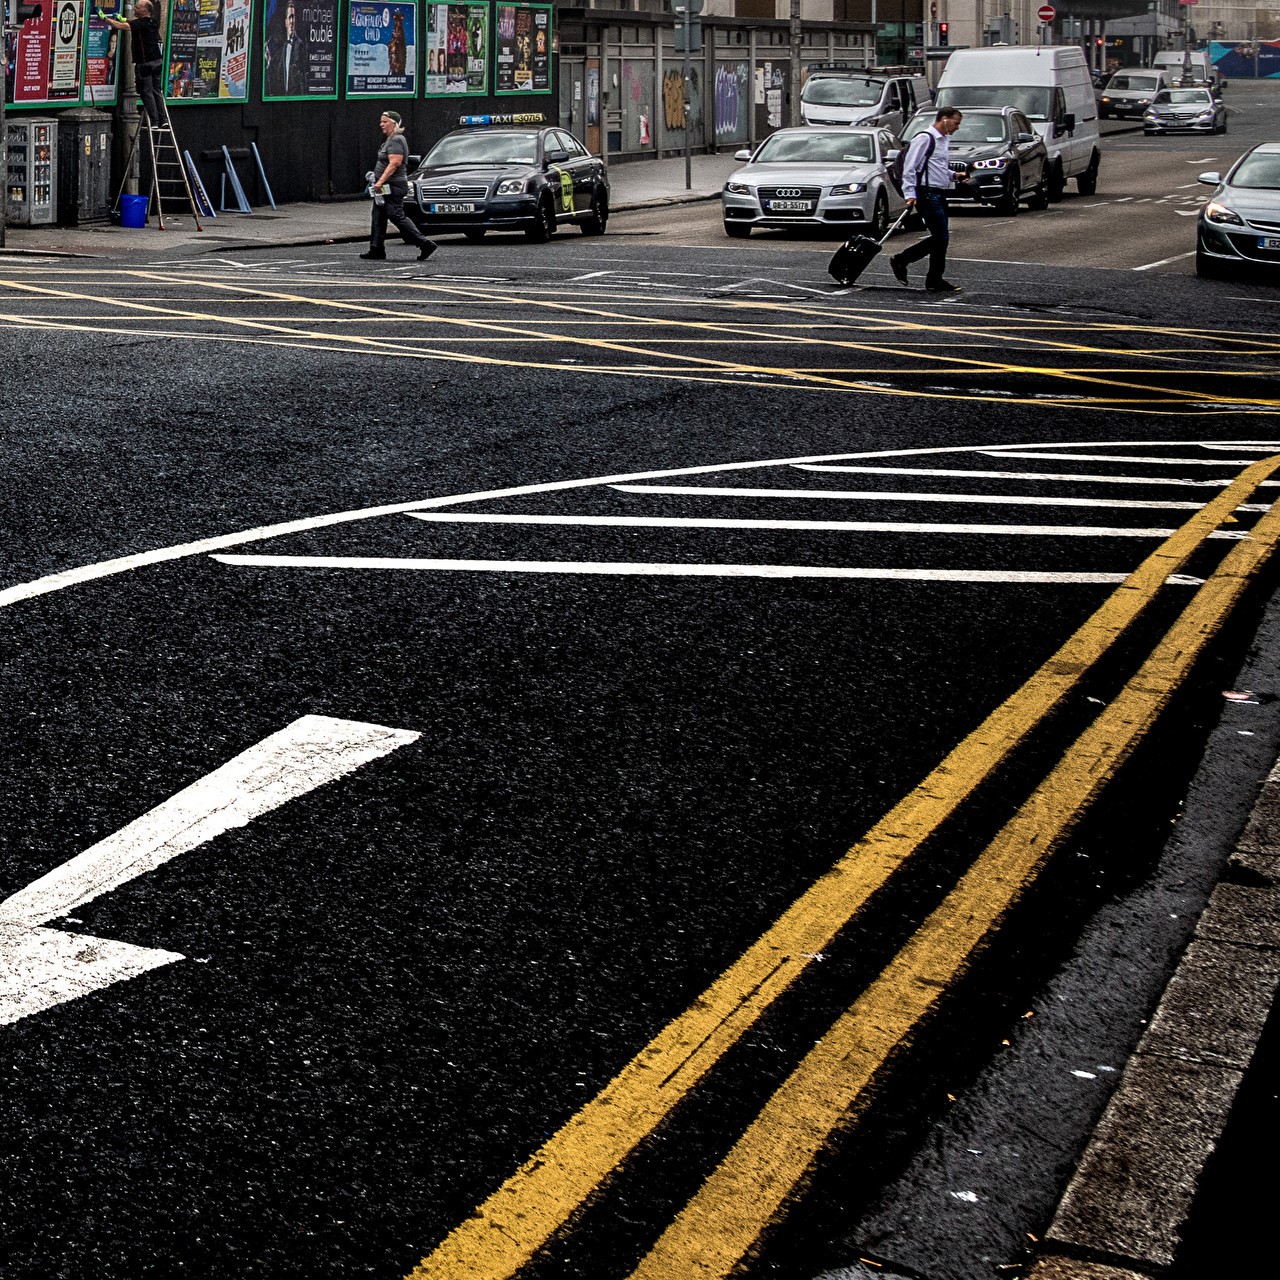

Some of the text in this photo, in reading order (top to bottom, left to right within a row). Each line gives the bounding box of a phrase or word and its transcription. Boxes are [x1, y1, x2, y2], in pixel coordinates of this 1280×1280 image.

[302, 5, 334, 22] michael
[309, 25, 333, 42] bublé
[490, 115, 512, 123] TAXI
